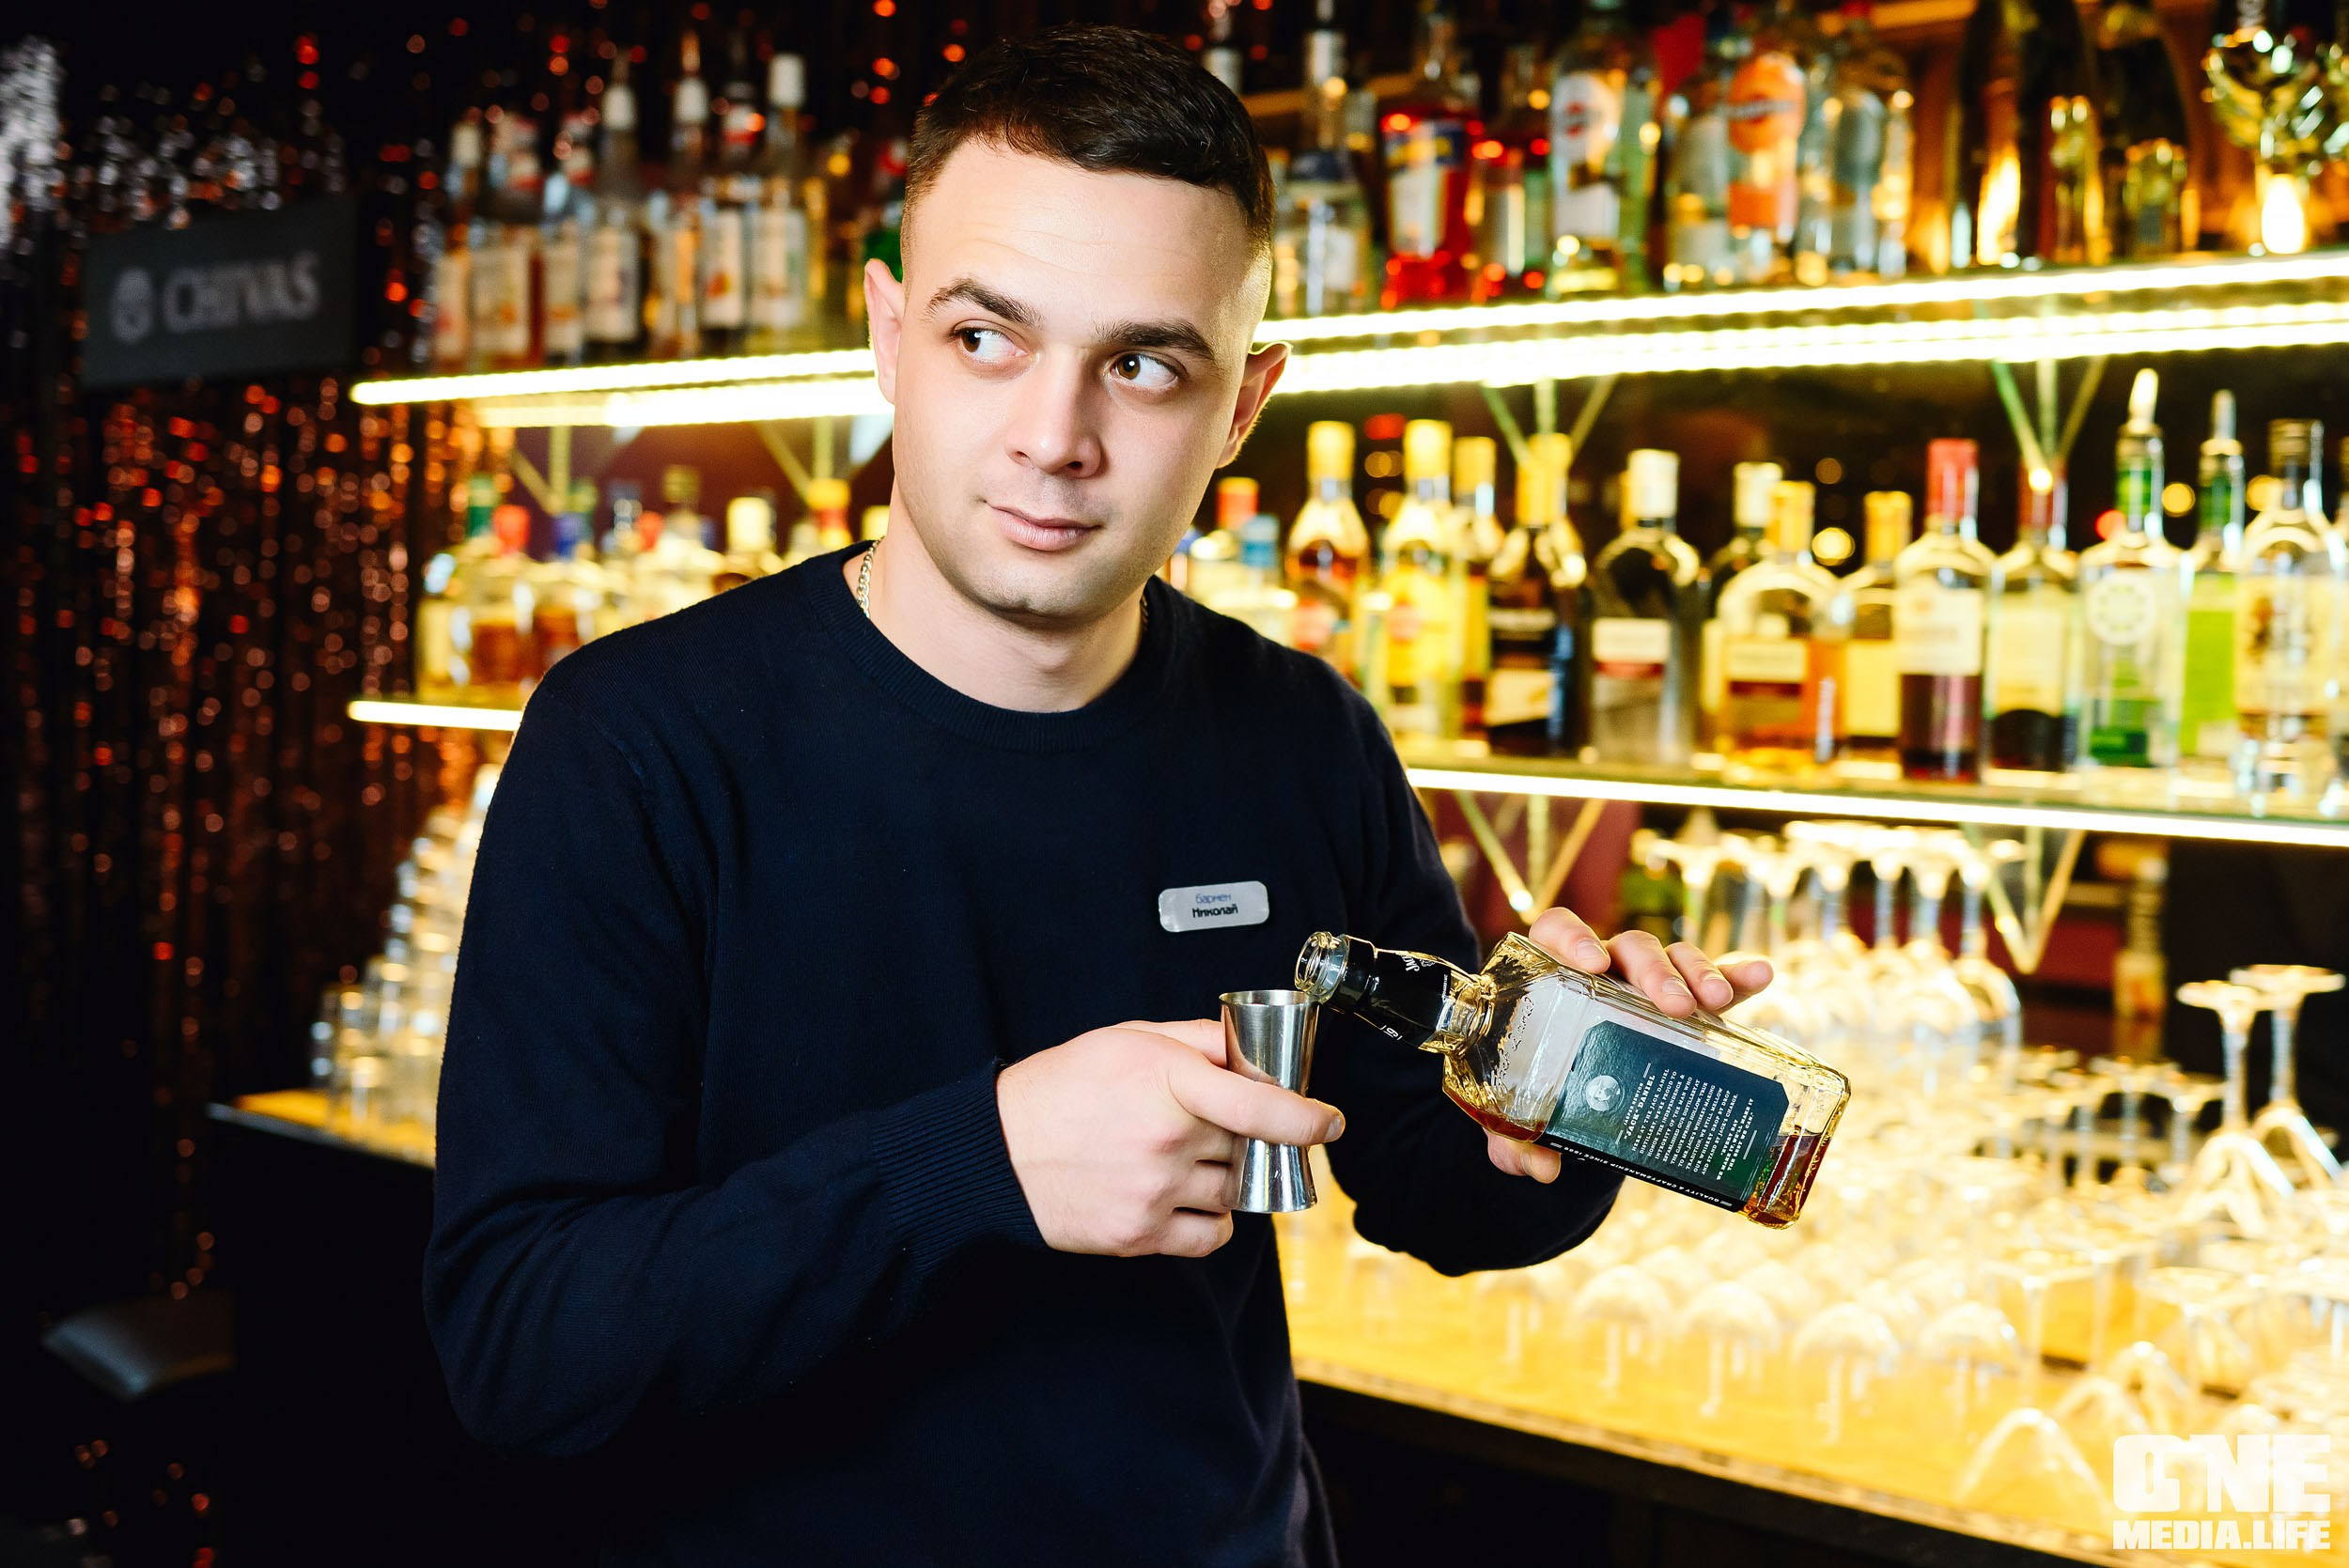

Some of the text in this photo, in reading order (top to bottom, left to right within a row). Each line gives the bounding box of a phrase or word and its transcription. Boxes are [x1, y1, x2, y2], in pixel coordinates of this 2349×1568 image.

[1191, 903, 1238, 918] Николай
[1623, 1082, 1643, 1125] JASPER NEWTON
[1623, 1074, 1656, 1140] "JACK" DANIEL
[1631, 1067, 1670, 1151] HERE AT THE JACK DANIEL
[1646, 1136, 1658, 1157] HONOR
[1656, 1124, 1664, 1136] THE
[1660, 1080, 1683, 1123] INDEPENDENCE
[1654, 1101, 1665, 1119] WE'RE
[1661, 1079, 1673, 1100] PROUD
[1670, 1070, 1677, 1080] TO
[1654, 1076, 1693, 1159] INTEGRITY OF THE MAN WHO
[1699, 1127, 1706, 1138] WE
[1703, 1111, 1713, 1127] STILL
[1709, 1087, 1723, 1111] MELLOW
[1662, 1128, 1680, 1162] ESTABLISHED
[1676, 1116, 1685, 1128] OUR
[1670, 1153, 1678, 1165] THE
[1674, 1139, 1684, 1153] CAVE
[1680, 1120, 1692, 1139] SPRING
[1698, 1081, 1708, 1096] TRUE
[1692, 1159, 1702, 1172] OUR
[1698, 1132, 1713, 1159] WHISKEY
[1710, 1114, 1720, 1131] DROP
[1720, 1090, 1731, 1106] DROP
[1701, 1162, 1709, 1175] AND
[1705, 1143, 1718, 1162] STAND
[1717, 1117, 1729, 1137] JACK'S
[1716, 1171, 1723, 1180] WE
[1720, 1152, 1731, 1170] MAKE
[1732, 1125, 1743, 1143] WE'LL
[1739, 1106, 1750, 1124] MAKE
[1748, 1097, 1754, 1106] IT
[1730, 1119, 1738, 1131] DAY
[1583, 1152, 1608, 1165] SINCE
[1677, 1158, 1685, 1167] TO
[1681, 1148, 1689, 1158] MR.
[1685, 1130, 1697, 1149] JACK'S
[1726, 1157, 1735, 1171] THE
[1733, 1141, 1743, 1157] BEST
[1739, 1129, 1747, 1140] WE
[1610, 1160, 1677, 1188] CRAFTSMANSHIP
[1685, 1187, 1719, 1203] QUALITY
